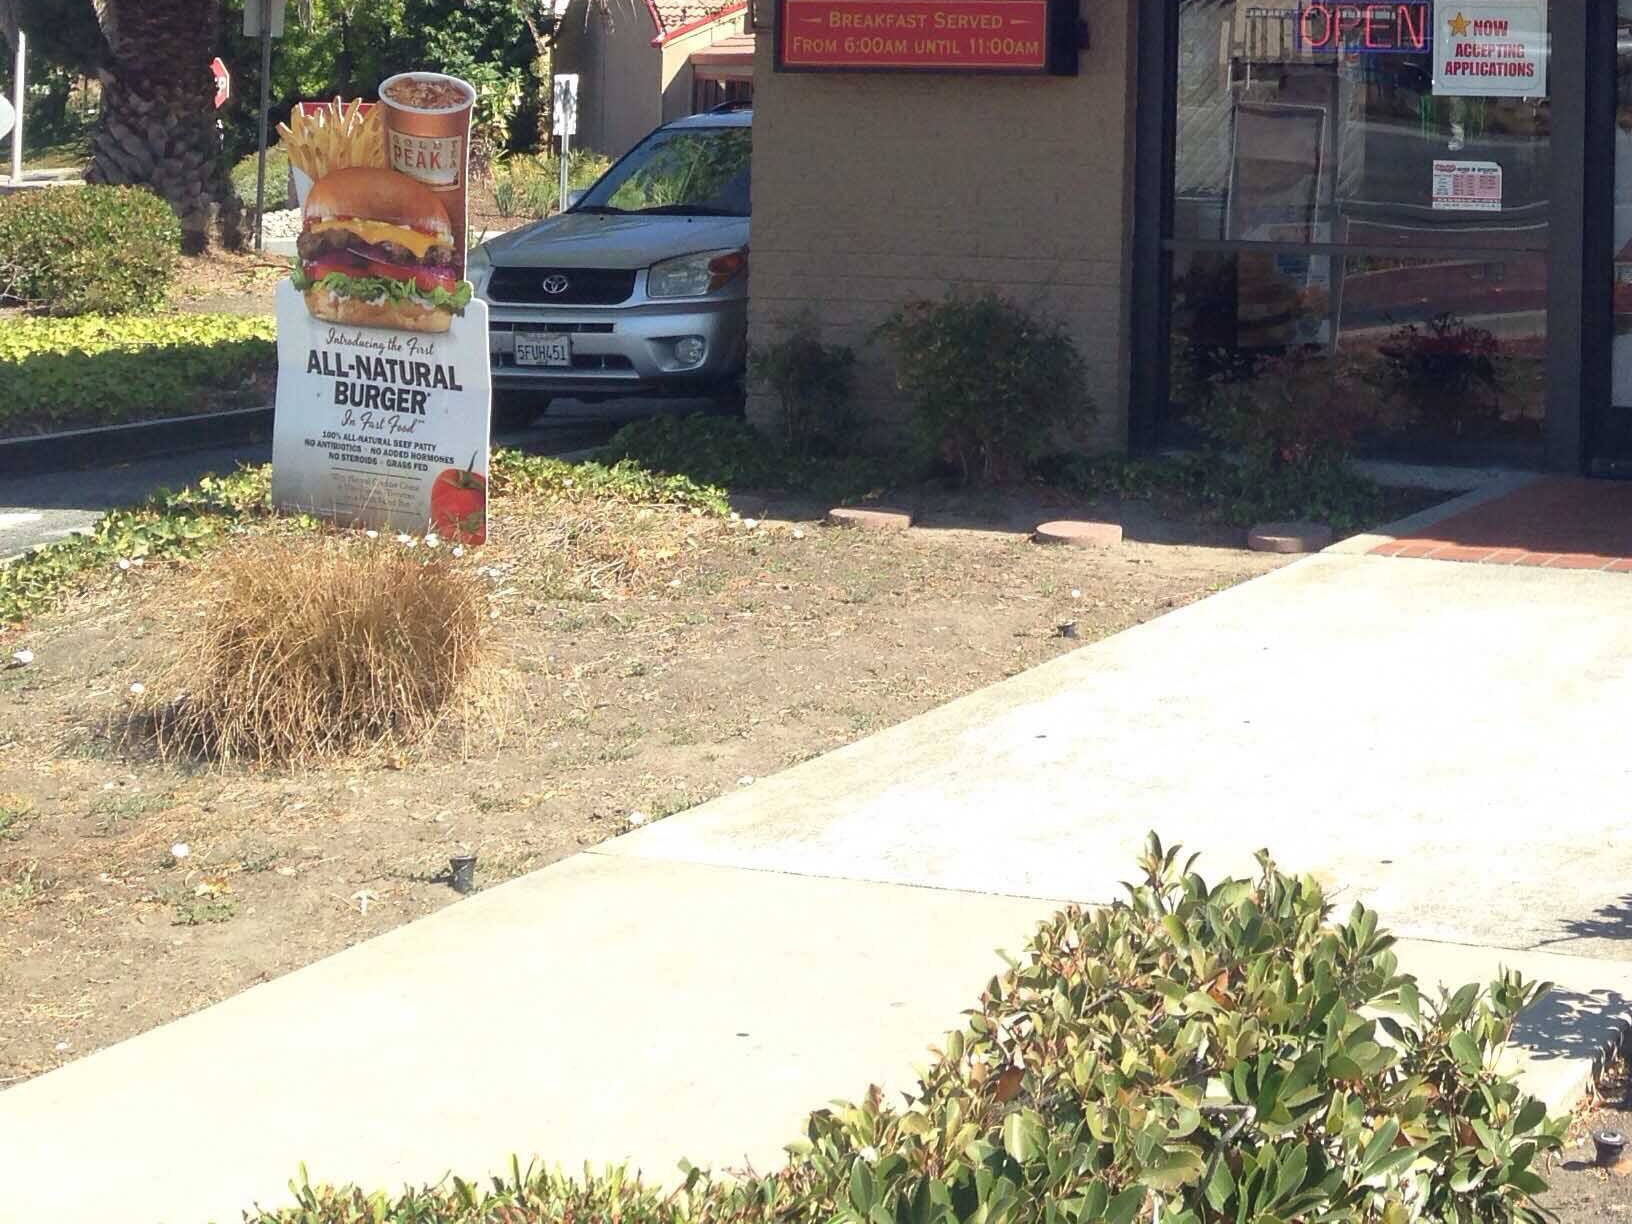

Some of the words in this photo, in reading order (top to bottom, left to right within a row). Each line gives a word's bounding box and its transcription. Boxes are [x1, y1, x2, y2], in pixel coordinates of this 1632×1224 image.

[829, 11, 926, 29] BREAKFAST
[933, 11, 1003, 29] SERVED
[1300, 3, 1425, 49] OPEN
[1473, 20, 1508, 37] NOW
[793, 36, 837, 53] FROM
[844, 36, 907, 54] 6:00AM
[914, 38, 961, 54] UNTIL
[969, 37, 1040, 56] 11:00AM
[1455, 43, 1525, 58] ACCEPTING
[1444, 62, 1535, 77] APPLICATIONS
[393, 144, 441, 169] PEAK
[326, 327, 386, 355] Introducing
[387, 336, 402, 352] the
[406, 336, 435, 357] First
[306, 348, 463, 392] ALL-NATURAL
[333, 380, 428, 416] BURGER
[304, 438, 316, 448] NO
[316, 440, 362, 453] ANTIBIOTICS
[370, 447, 382, 456] NO
[382, 448, 409, 459] ADDED
[410, 452, 455, 465] HORMONES
[343, 432, 391, 447] ALL-NATURAL
[393, 439, 412, 450] BEEF
[413, 441, 437, 452] PATTY
[328, 451, 340, 461] NO
[340, 453, 378, 466] STEROIDS
[386, 459, 412, 470] GRASS
[413, 462, 429, 472] FED
